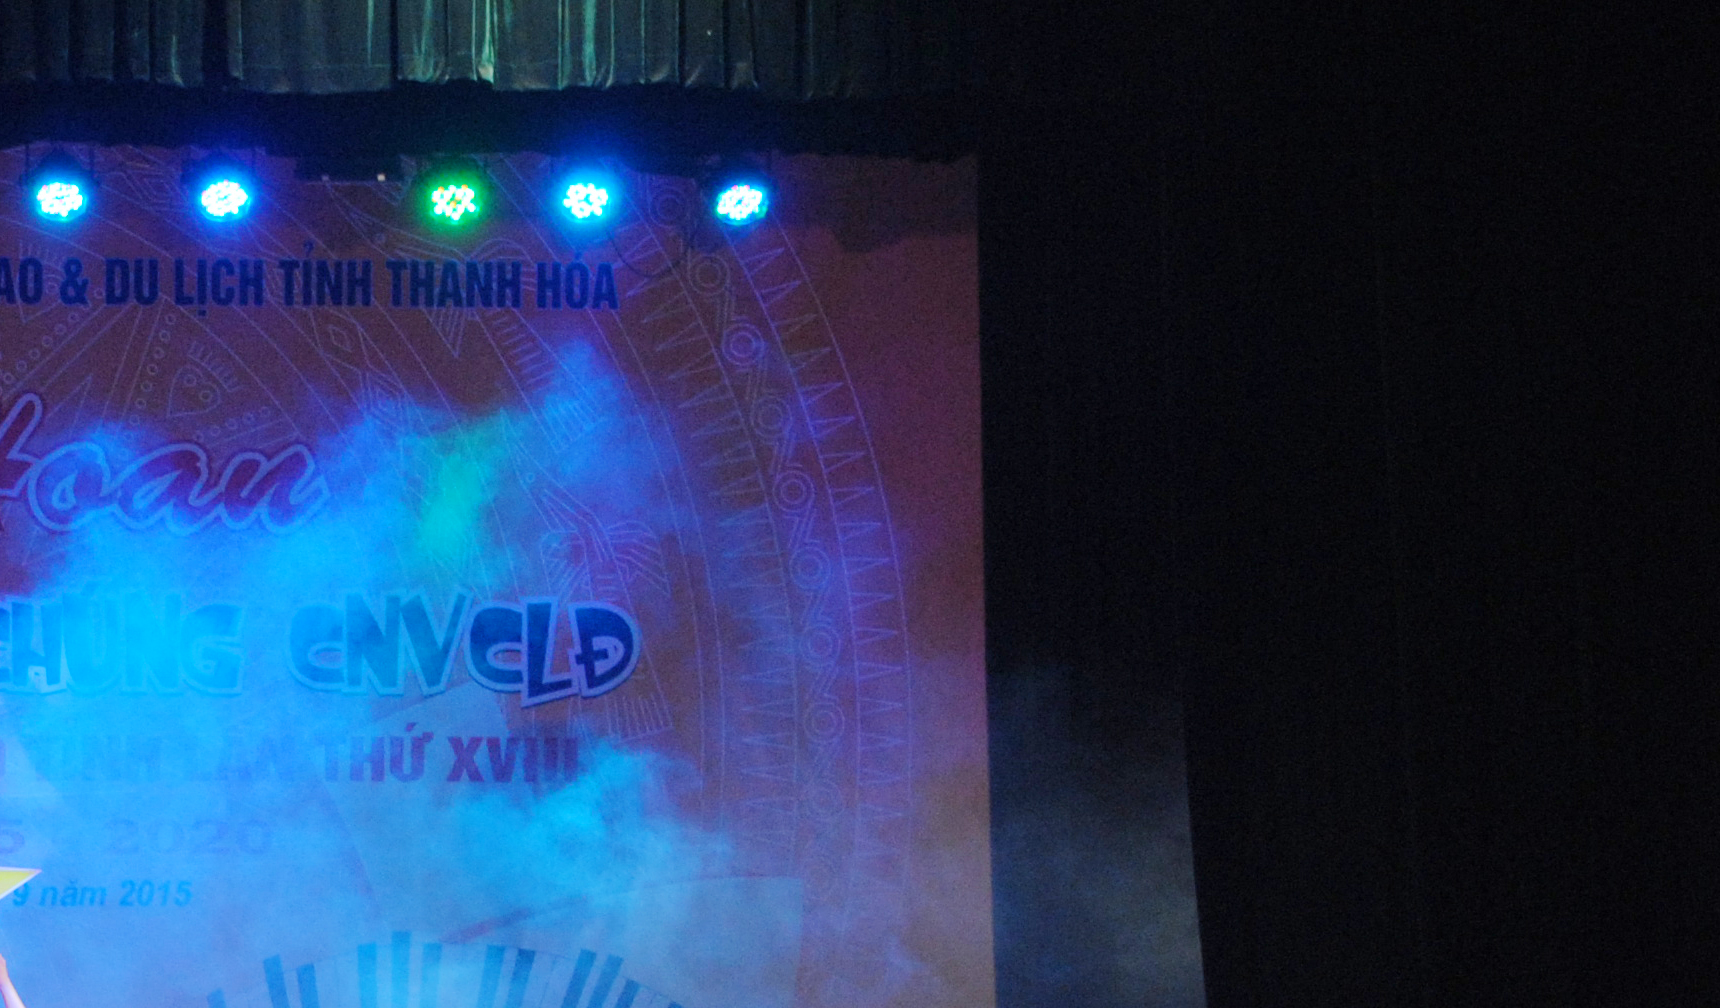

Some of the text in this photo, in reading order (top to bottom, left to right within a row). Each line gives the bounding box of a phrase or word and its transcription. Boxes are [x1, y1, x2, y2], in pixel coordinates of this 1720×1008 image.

[58, 259, 89, 306] &
[105, 258, 160, 306] DU
[173, 257, 265, 317] LỊCH
[281, 242, 372, 308] TỈNH
[386, 260, 522, 309] THANH
[536, 246, 620, 310] HÓA
[286, 585, 642, 708] CNVCLĐ
[322, 722, 434, 783] THỨ
[447, 736, 579, 784] XVIII
[38, 880, 107, 907] năm
[118, 879, 194, 907] 2015
